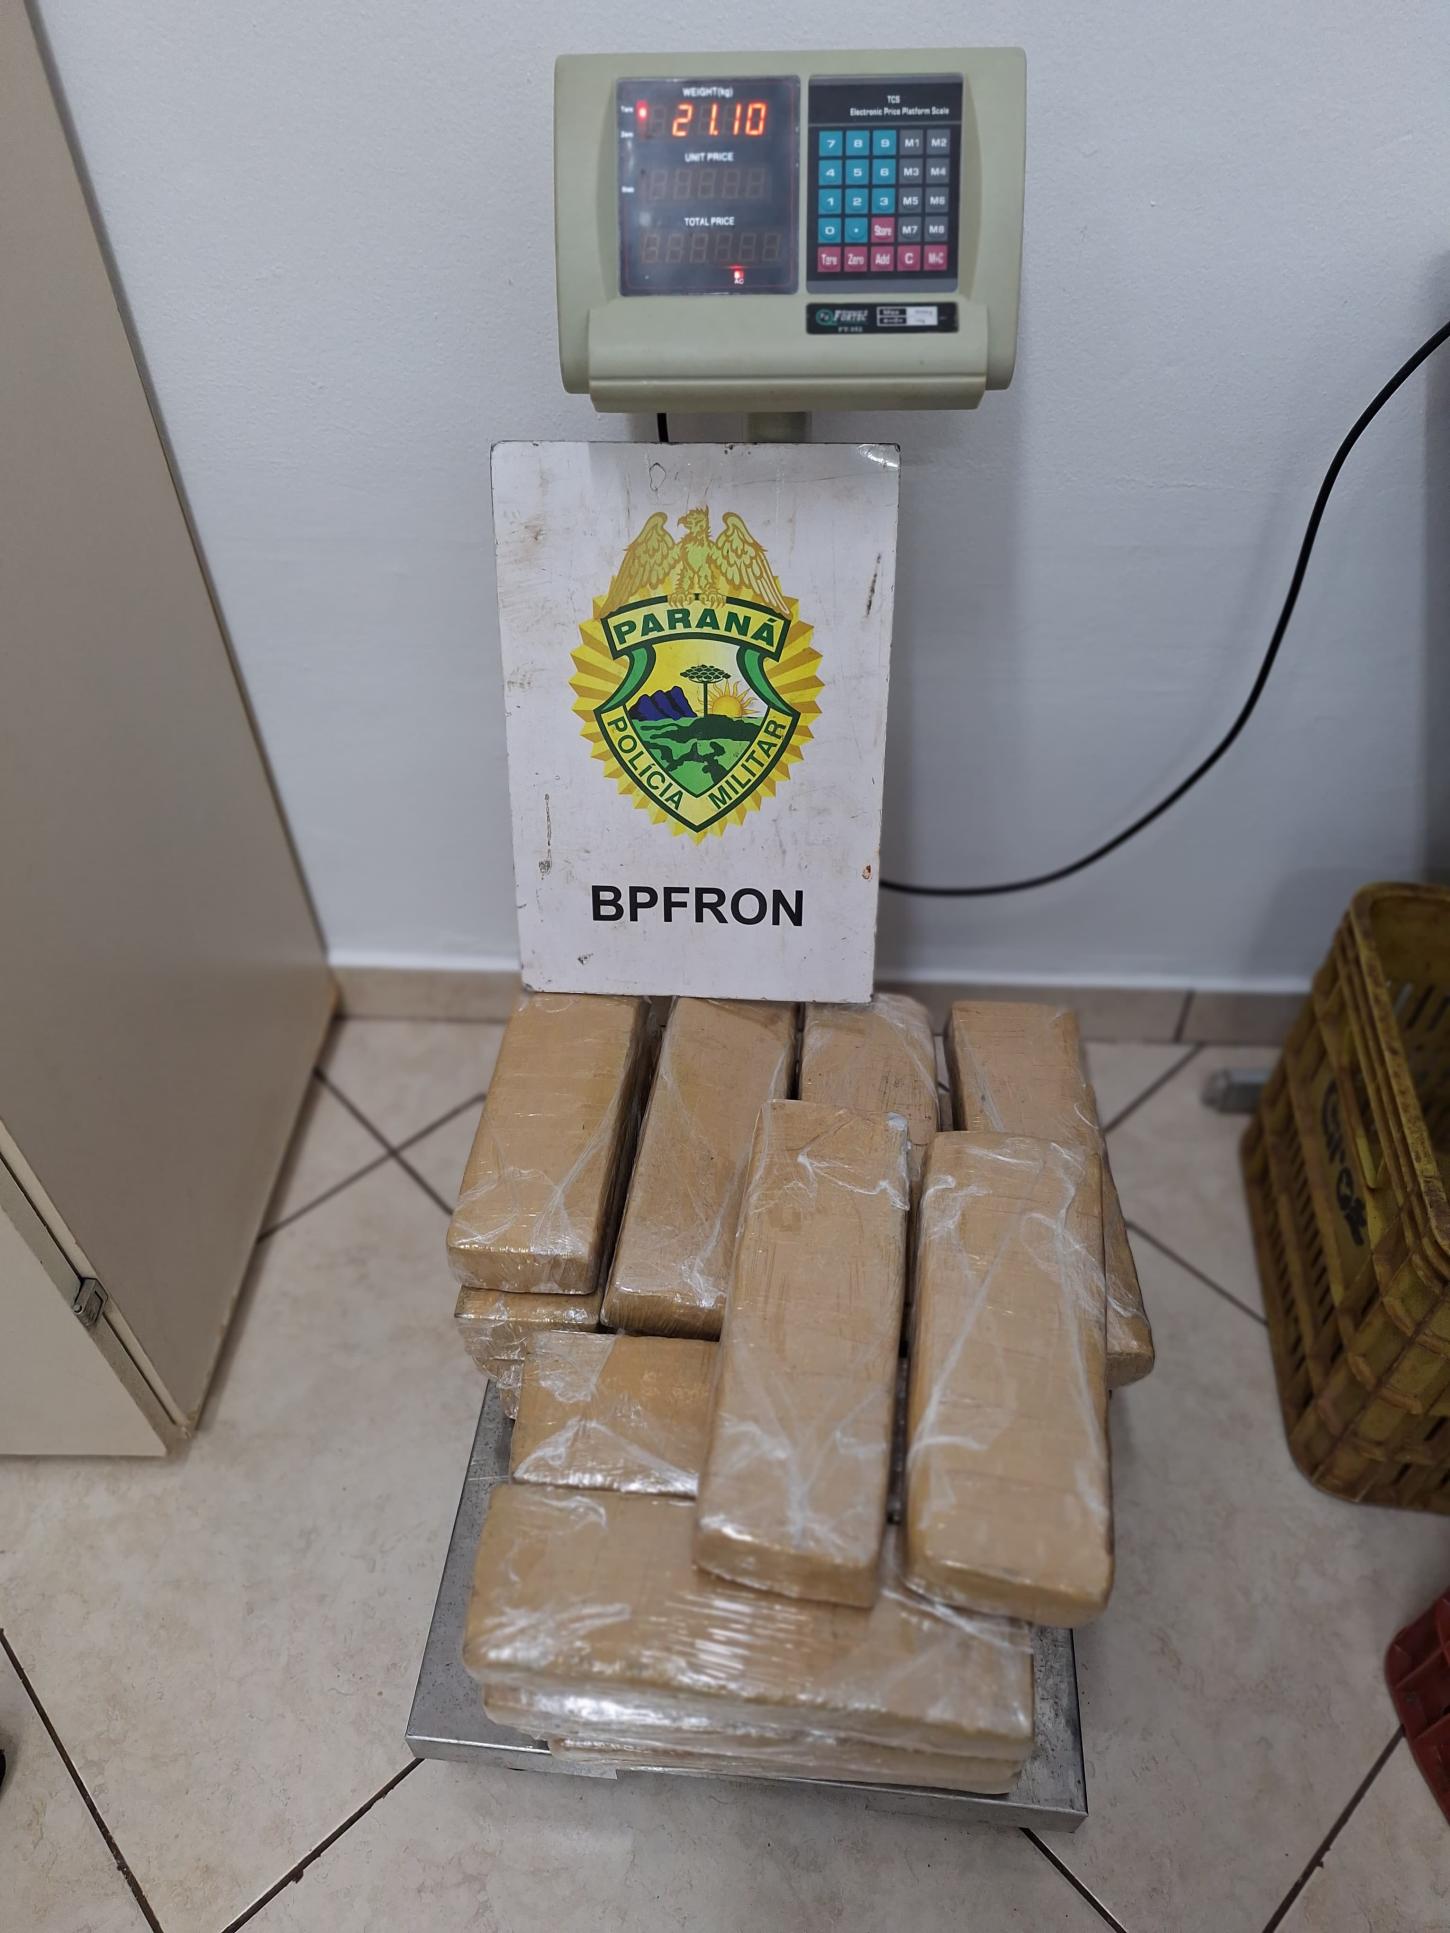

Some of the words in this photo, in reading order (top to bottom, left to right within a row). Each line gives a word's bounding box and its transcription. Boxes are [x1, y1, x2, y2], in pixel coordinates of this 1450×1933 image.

[682, 87, 734, 98] WEIGHT(kg)
[887, 95, 900, 104] TCS
[850, 107, 882, 116] Electronic
[884, 107, 900, 116] Price
[902, 106, 930, 115] Platform
[931, 106, 949, 115] Scale
[671, 102, 768, 137] 21.10
[827, 139, 836, 148] 7
[853, 139, 863, 148] 8
[880, 138, 890, 148] 9
[904, 138, 919, 147] M1
[931, 138, 947, 147] M2
[685, 153, 705, 162] UNIT
[707, 152, 734, 162] PRICE
[826, 168, 836, 177] 4
[853, 168, 862, 177] 5
[880, 168, 889, 176] 6
[903, 167, 919, 176] M3
[931, 167, 947, 176] M4
[826, 197, 834, 206] 1
[852, 197, 862, 206] 2
[879, 197, 889, 206] 3
[903, 196, 919, 205] M5
[684, 217, 709, 227] TOTAL
[710, 216, 735, 226] PRICE
[825, 226, 835, 235] 0
[902, 225, 918, 235] M7
[821, 253, 837, 265] Tare
[848, 253, 865, 265] Zero
[875, 253, 890, 265] Add
[904, 252, 914, 264] C
[613, 608, 776, 647] PARANÁ
[607, 716, 683, 811] POLÍCIA
[707, 718, 787, 811] MILITAR
[591, 885, 804, 927] BPFRON
